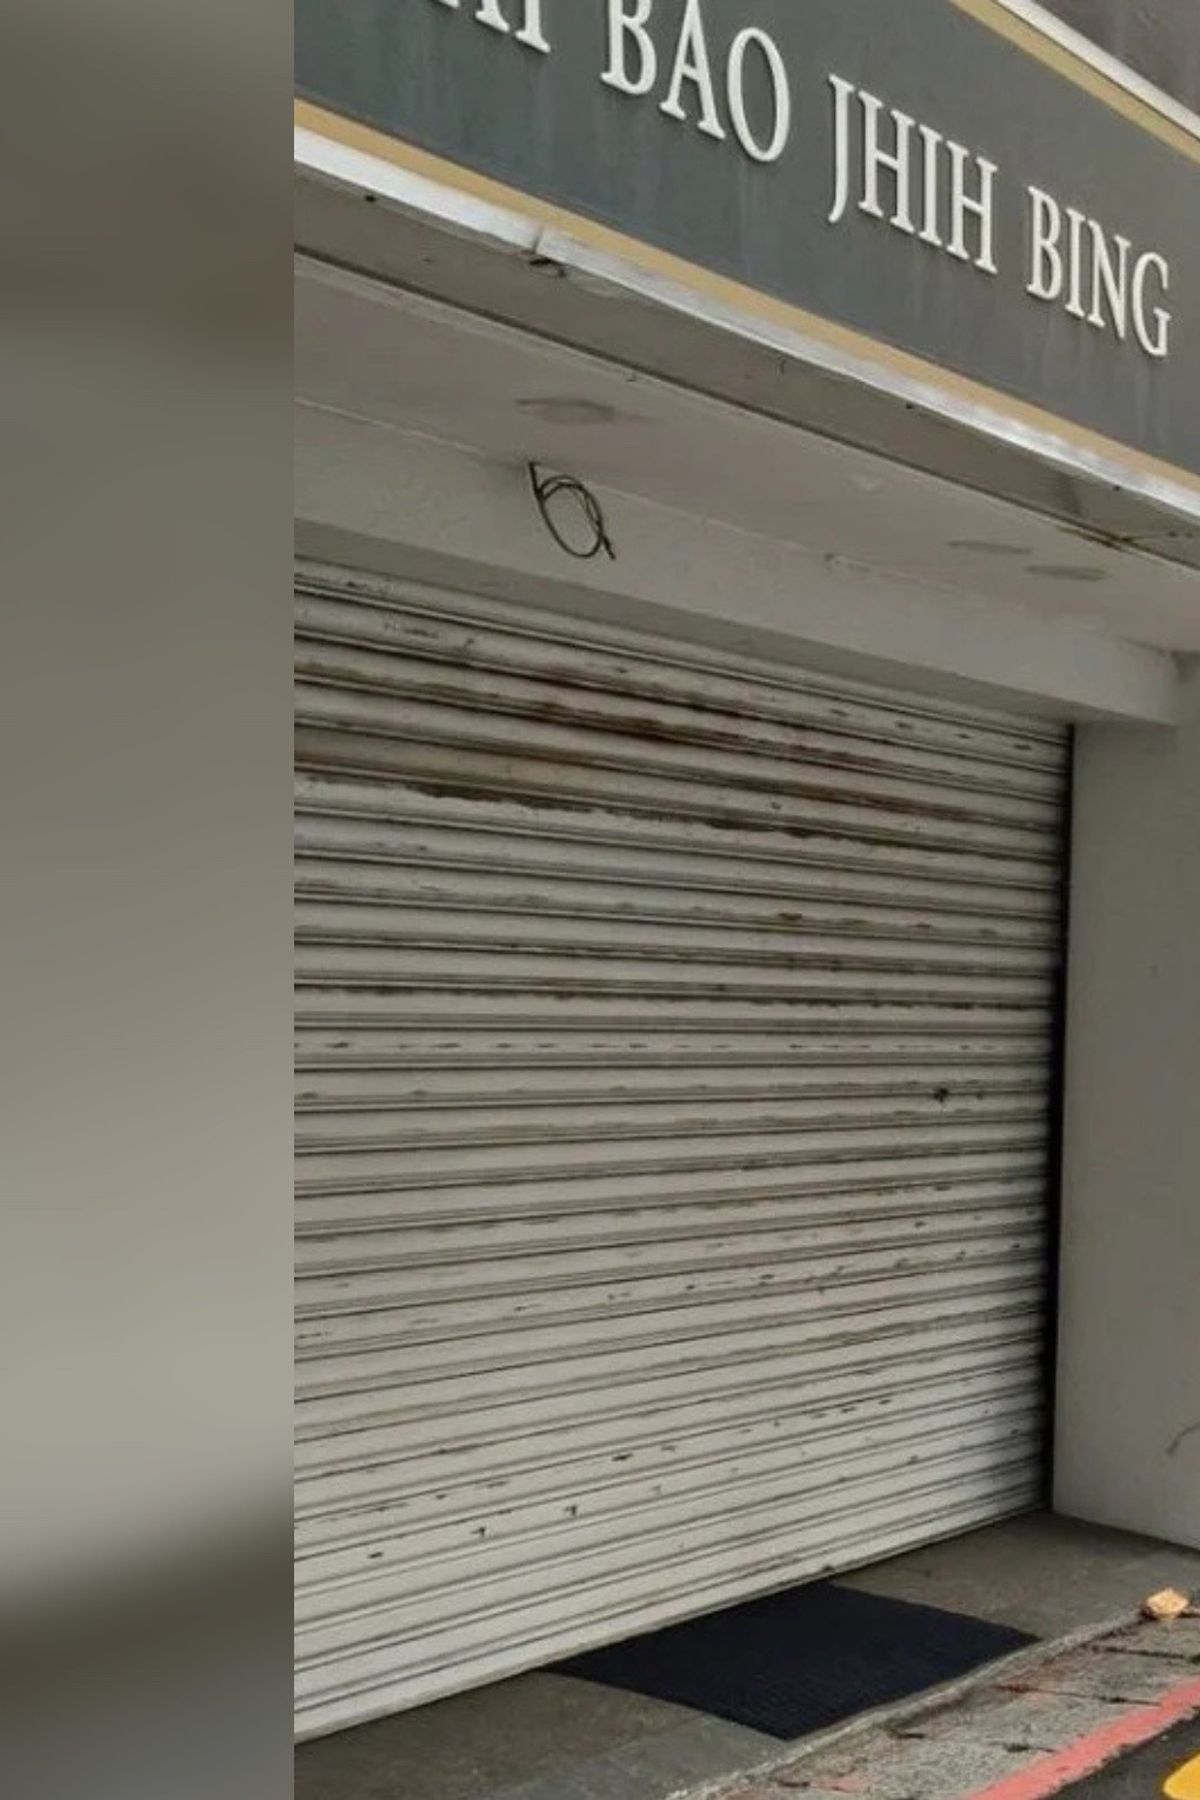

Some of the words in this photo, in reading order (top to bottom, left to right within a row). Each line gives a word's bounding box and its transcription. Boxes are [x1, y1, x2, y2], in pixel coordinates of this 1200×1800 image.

[601, 0, 791, 163] BAO
[827, 73, 999, 275] JHIH
[1024, 185, 1171, 358] BING
